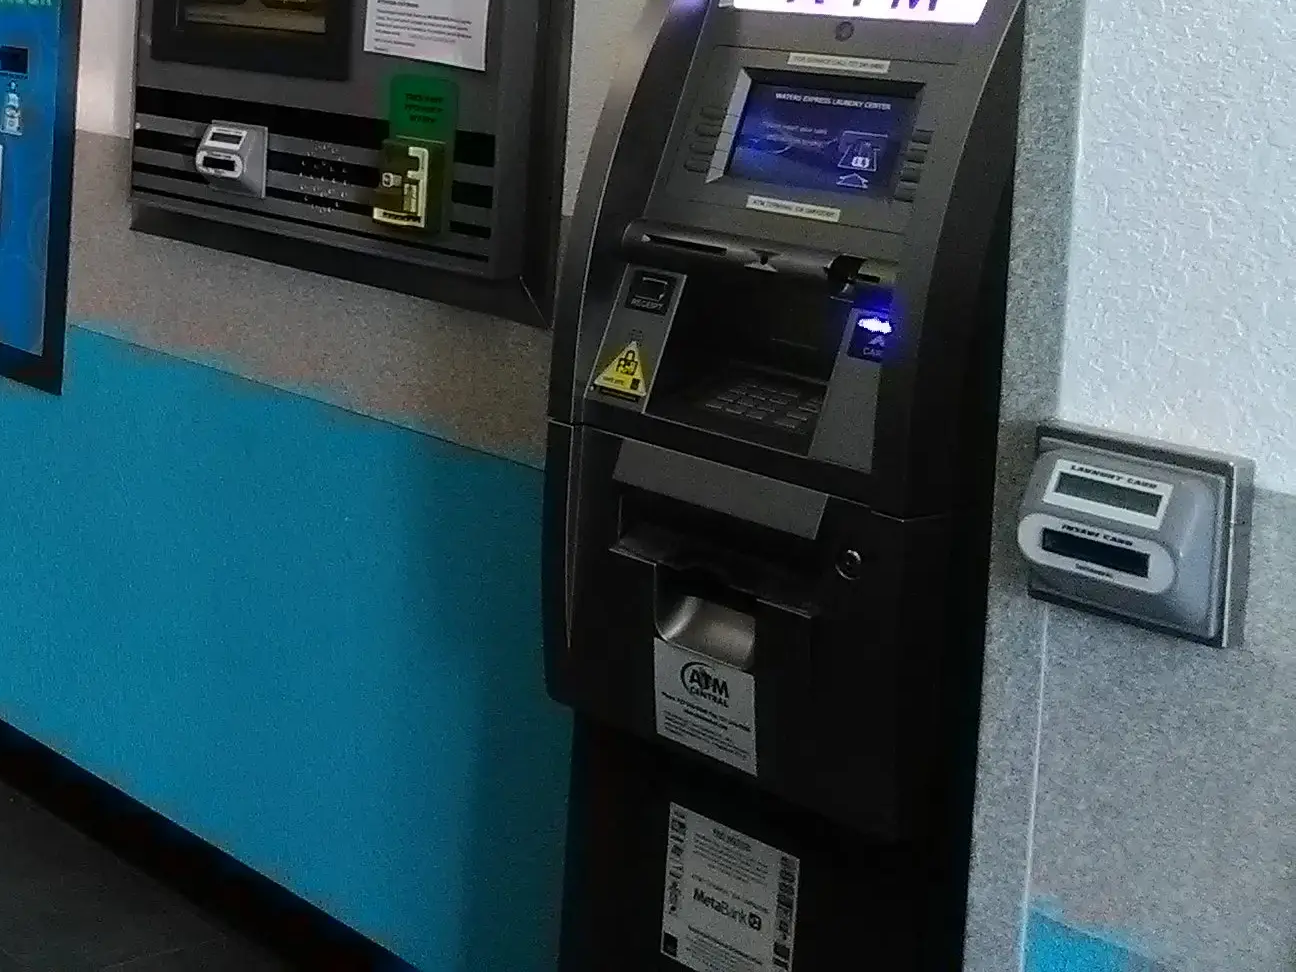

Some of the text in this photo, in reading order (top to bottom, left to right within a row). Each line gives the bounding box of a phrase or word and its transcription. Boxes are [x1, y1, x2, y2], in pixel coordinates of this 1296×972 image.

[803, 95, 831, 106] EXPRESS
[832, 97, 863, 109] LAUNDRY
[1127, 477, 1158, 490] CARD
[688, 668, 730, 700] ATM
[693, 887, 748, 926] MetaBank
